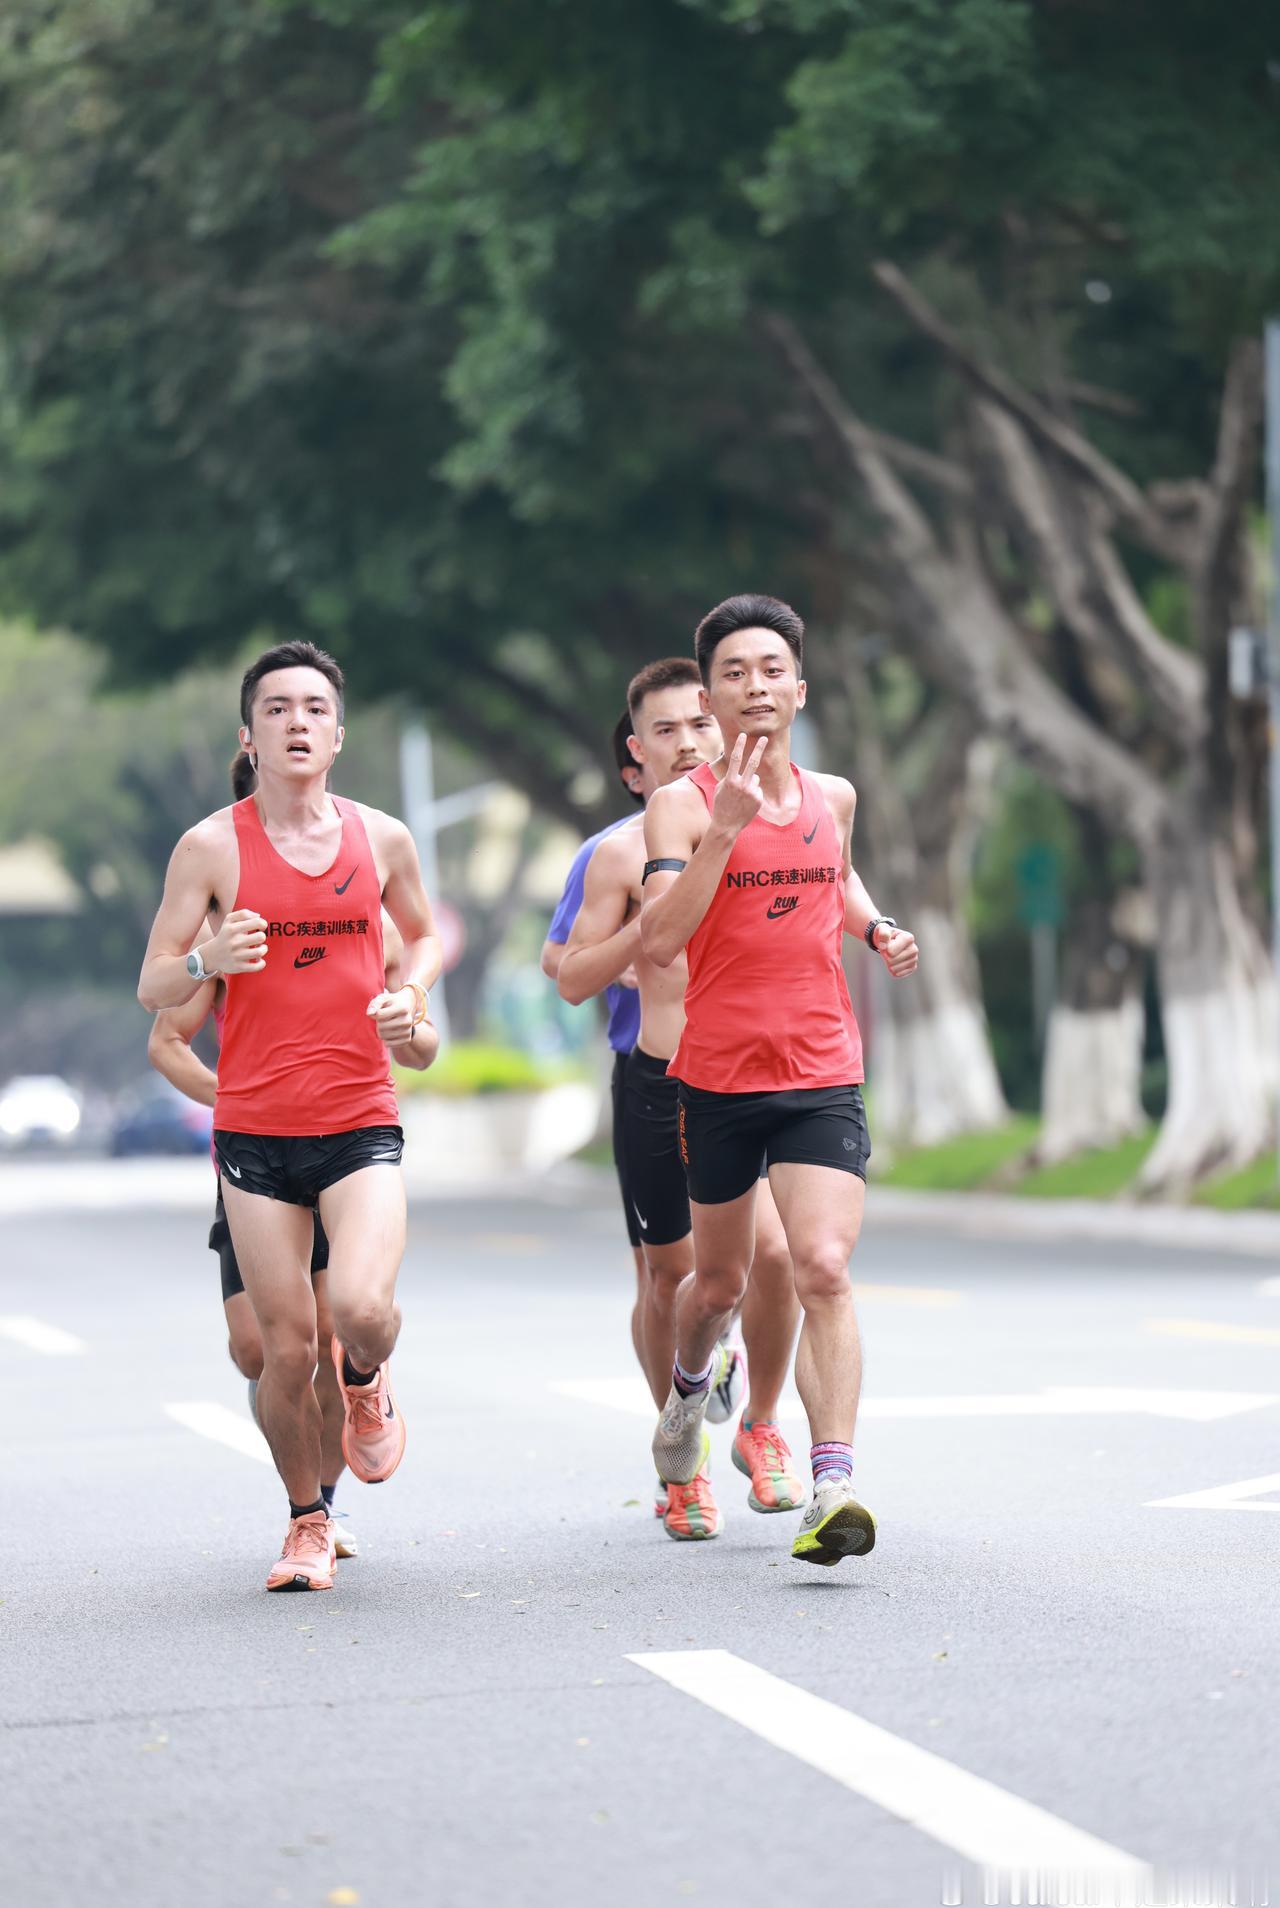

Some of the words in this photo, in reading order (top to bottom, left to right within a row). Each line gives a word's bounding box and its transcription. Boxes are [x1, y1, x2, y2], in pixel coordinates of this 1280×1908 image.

[727, 867, 836, 888] NRC疾速训练营
[773, 896, 799, 909] RUN
[264, 919, 369, 937] RC疾速训练营
[300, 947, 326, 959] RUN
